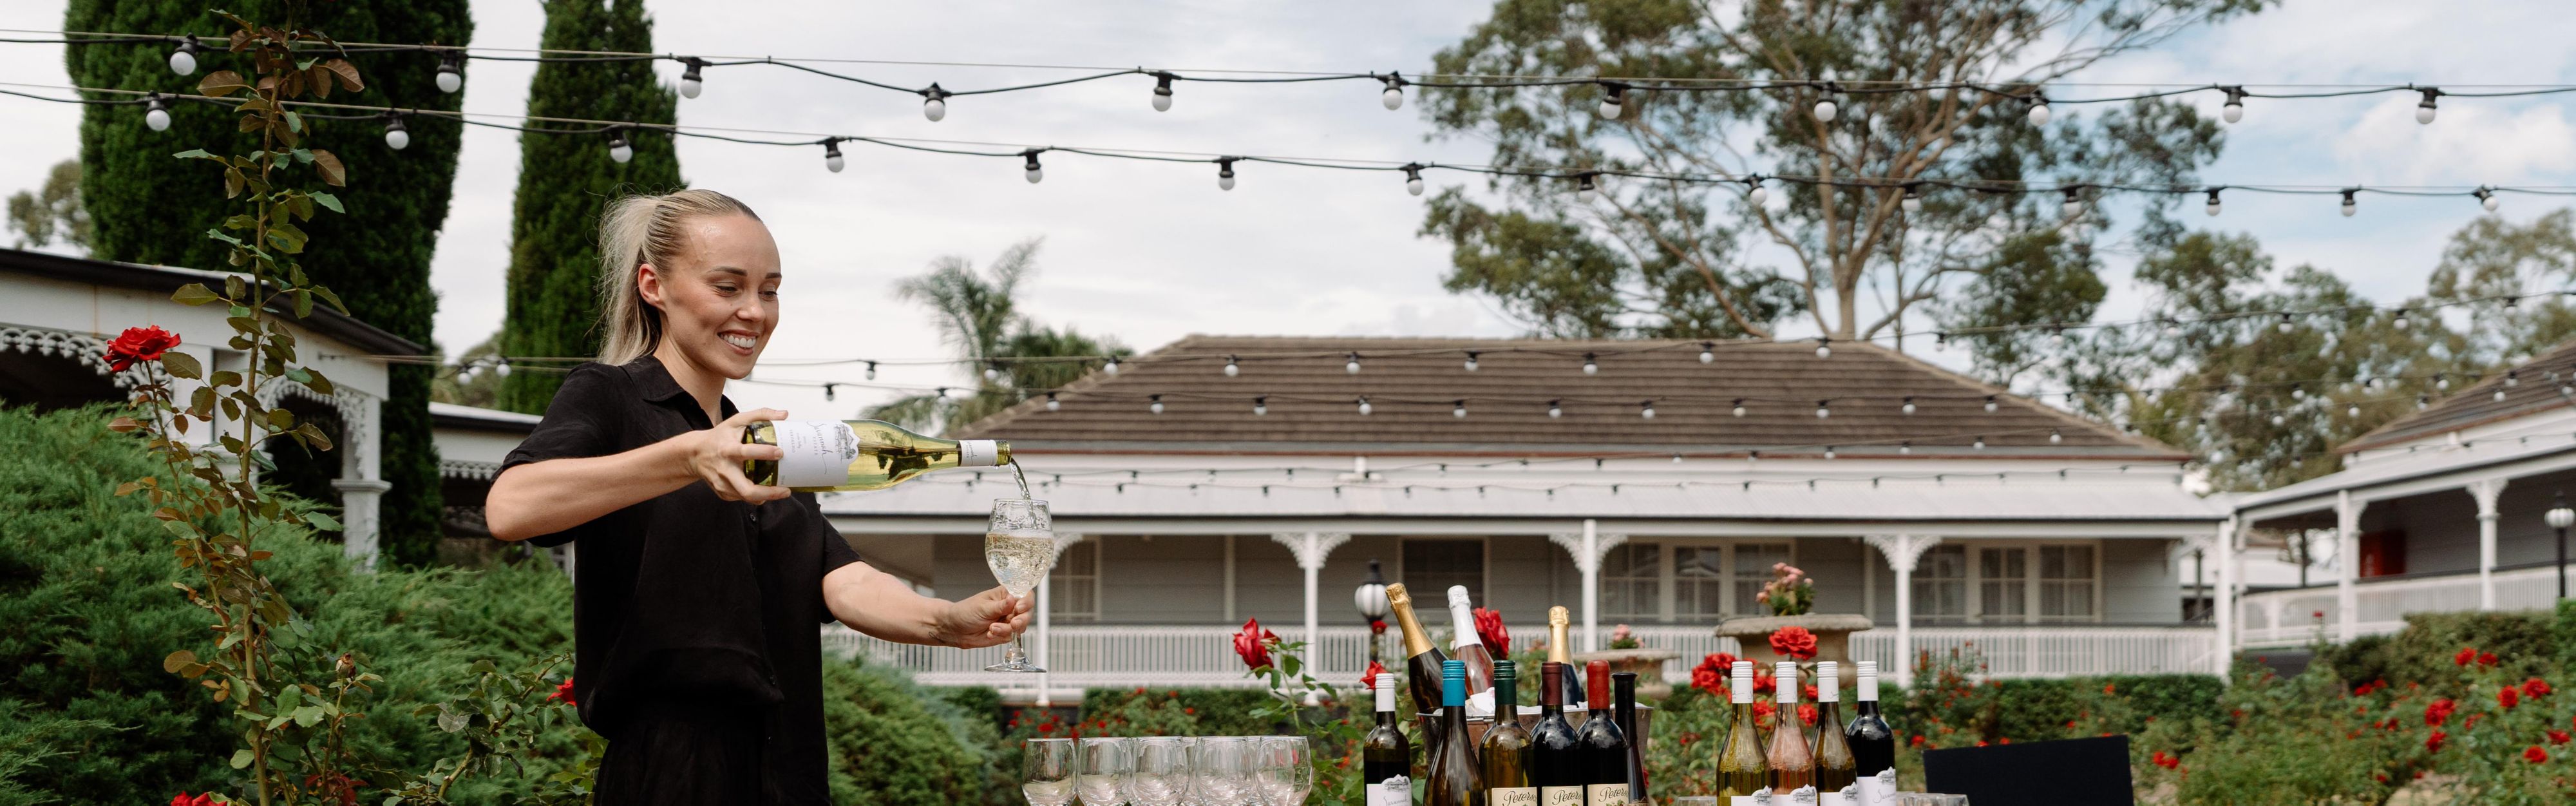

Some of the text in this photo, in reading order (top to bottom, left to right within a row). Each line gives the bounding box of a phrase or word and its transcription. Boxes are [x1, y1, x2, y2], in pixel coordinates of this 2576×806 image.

[806, 421, 833, 474] Savannah
[1502, 791, 1537, 806] Peterso
[1552, 789, 1582, 805] Peters
